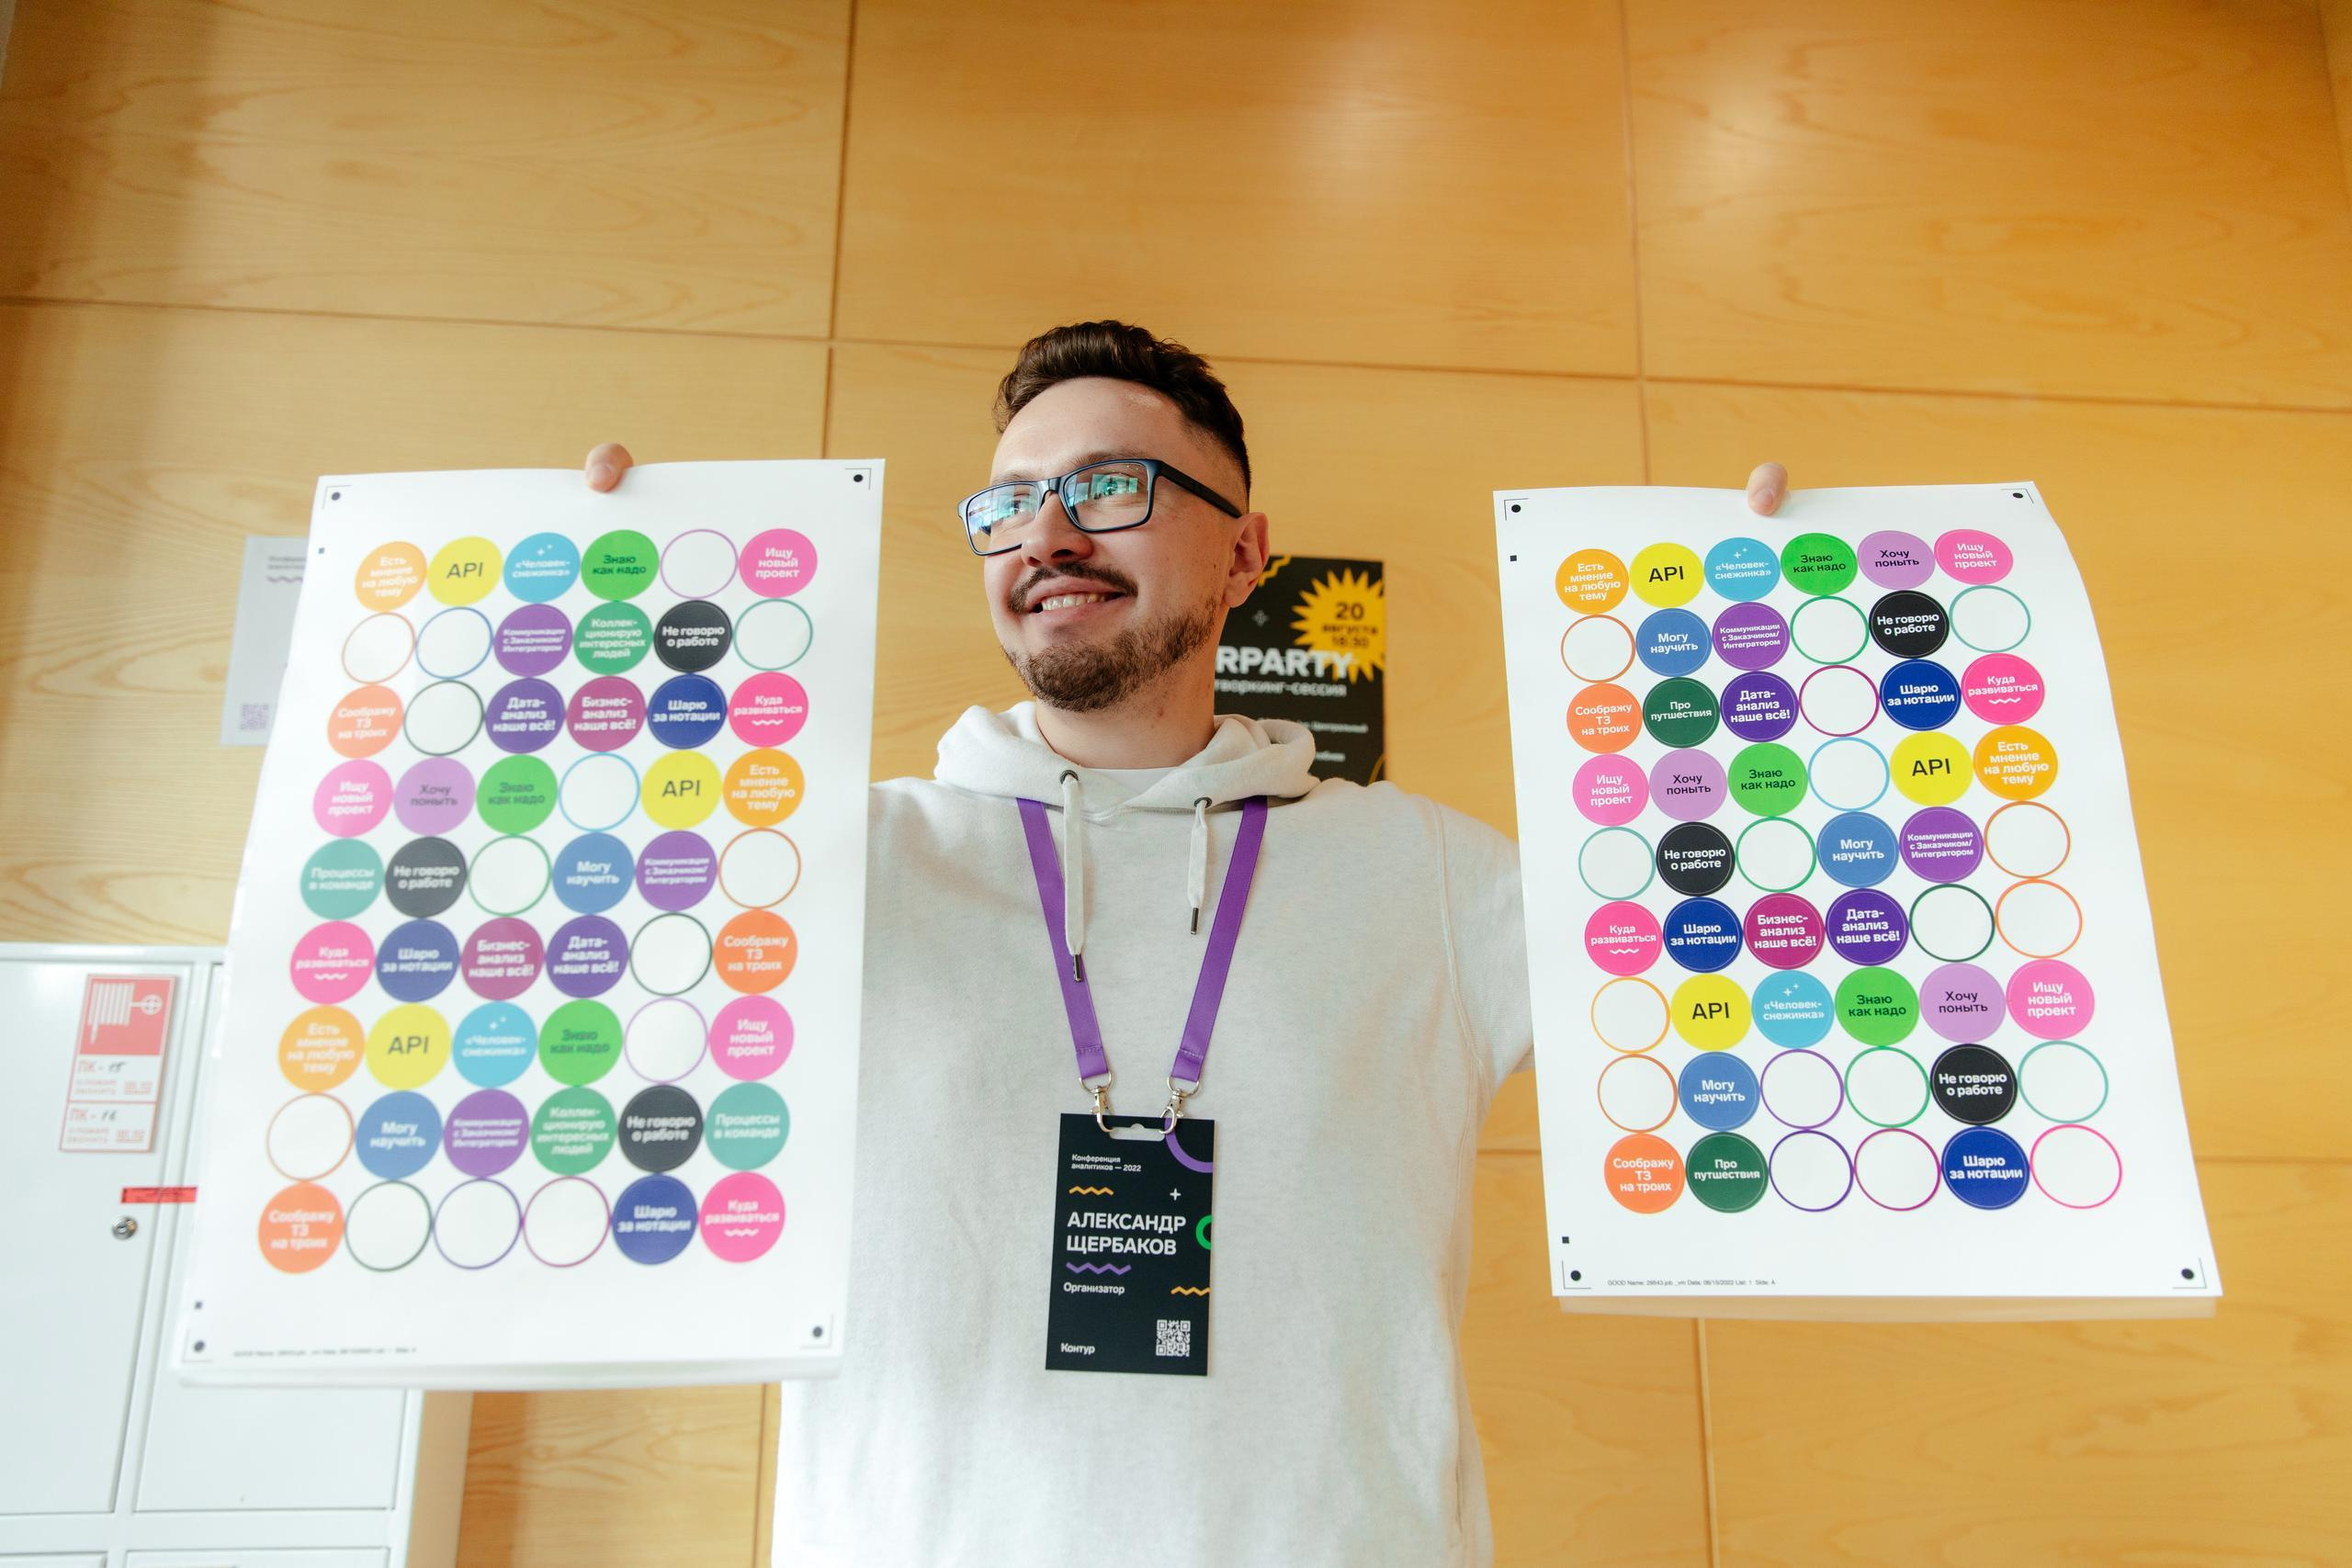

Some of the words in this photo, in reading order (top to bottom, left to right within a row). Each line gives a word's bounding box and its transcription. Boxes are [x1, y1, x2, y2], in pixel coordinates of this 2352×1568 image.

[765, 547, 793, 559] Ищу
[1957, 544, 1986, 552] Ищу
[1801, 555, 1833, 563] Знаю
[1880, 550, 1909, 558] Хочу
[1954, 551, 1994, 559] новый
[603, 554, 636, 565] Знаю
[758, 558, 798, 569] новый
[1577, 563, 1604, 572] Есть
[1715, 562, 1769, 570] «Человек-
[1816, 563, 1846, 571] надо
[1955, 560, 1997, 570] проект
[447, 562, 483, 579] API
[592, 567, 614, 576] как
[616, 566, 647, 576] надо
[755, 569, 800, 580] проект
[1648, 566, 1683, 582] API
[1714, 570, 1771, 580] снежинка»
[1570, 572, 1613, 582] мнение
[1580, 581, 1621, 591] любую
[1579, 592, 1607, 601] тему
[1335, 603, 1365, 621] 20
[1877, 616, 1894, 626] Не
[1894, 615, 1939, 624] говорю
[662, 626, 680, 637] Не
[680, 626, 724, 637] говорю
[1720, 625, 1780, 634] Коммуникации
[1894, 623, 1936, 636] работе
[1657, 633, 1689, 643] Могу
[1727, 631, 1780, 641] Заказчиком/
[666, 637, 676, 648] о
[676, 636, 718, 649] работе
[1723, 640, 1781, 649] Интегратором
[1650, 643, 1698, 654] научить
[1987, 676, 2016, 686] Куда
[1900, 684, 1939, 694] Шарю
[1968, 684, 2038, 695] развиваться
[755, 694, 783, 706] Куда
[1740, 690, 1776, 702] Дата-
[1904, 694, 1954, 705] нотации
[668, 699, 707, 712] Шарю
[735, 705, 801, 716] развиваться
[1576, 705, 1632, 716] Соображу
[1670, 701, 1690, 711] Про
[1736, 701, 1780, 711] анализ
[653, 712, 667, 723] за
[669, 712, 718, 722] нотации
[1596, 716, 1611, 725] ТЗ
[1651, 710, 1712, 721] путшествия
[1731, 714, 1763, 722] наше
[1765, 709, 1790, 720] всё!
[1597, 725, 1630, 735] троих
[1997, 741, 2029, 751] Есть
[1990, 752, 2040, 762] мнение
[1912, 759, 1951, 776] API
[1984, 766, 2000, 774] на
[2003, 762, 2049, 773] любую
[1597, 774, 1623, 784] Ищу
[1673, 774, 1702, 784] Хочу
[1749, 769, 1782, 779] Знаю
[1741, 782, 1762, 790] как
[1765, 780, 1795, 789] надо
[2001, 775, 2035, 785] тему
[662, 780, 700, 796] API
[1591, 784, 1630, 795] новый
[1667, 785, 1711, 795] поныть
[1590, 796, 1633, 807] проект
[1907, 832, 1973, 841] Коммуникации
[1840, 839, 1873, 851] Могу
[1917, 840, 1973, 850] Заказчиком/
[1664, 850, 1680, 860] Не
[1682, 850, 1725, 859] говорю
[1832, 851, 1884, 863] научить
[1911, 850, 1973, 858] Интегратором
[1680, 858, 1722, 871] работе
[1847, 908, 1884, 921] Дата-
[1758, 915, 1808, 925] Бизнес-
[1610, 925, 1635, 935] Куда
[1683, 924, 1722, 935] Шарю
[1842, 921, 1889, 931] анализ
[1760, 927, 1805, 937] анализ
[1837, 934, 1871, 943] наше
[1873, 931, 1900, 942] всё!
[1591, 935, 1656, 944] развиваться
[1670, 938, 1685, 946] за
[1686, 936, 1736, 945] нотации
[1755, 940, 1788, 948] наше
[1790, 936, 1817, 947] всё!
[2032, 982, 2064, 995] Ищу
[1857, 995, 1893, 1005] Знаю
[1946, 991, 1977, 1003] Хочу
[2028, 994, 2073, 1005] новый
[1764, 1001, 1822, 1010] «Человек-
[1939, 1004, 1988, 1013] поныть
[1692, 1002, 1729, 1020] API
[1763, 1011, 1825, 1021] снежинка»
[1849, 1009, 1871, 1017] как
[1874, 1007, 1906, 1017] надо
[2028, 1007, 2076, 1018] проект
[388, 1036, 429, 1055] API
[1939, 1073, 1957, 1084] Не
[1959, 1074, 2007, 1084] говорю
[1702, 1079, 1735, 1092] Могу
[1946, 1087, 1955, 1096] о
[1957, 1083, 2003, 1098] работе
[1694, 1093, 1746, 1104] научить
[1071, 1154, 1121, 1164] Конференция
[1613, 1158, 1674, 1169] Соображу
[1962, 1156, 2006, 1168] Шарю
[1071, 1163, 1114, 1171] аналитиков
[1714, 1159, 1737, 1170] Про
[1634, 1170, 1652, 1180] ТЗ
[1694, 1171, 1760, 1181] путшествия
[1950, 1170, 1965, 1179] за
[1967, 1169, 2023, 1179] нотации
[1620, 1183, 1634, 1191] на
[1636, 1183, 1672, 1193] троих
[1067, 1212, 1187, 1232] АЛЕКСАНДР
[1066, 1235, 1177, 1256] ЩЕРБАКОВ
[1063, 1282, 1125, 1295] Организатор
[1060, 1343, 1095, 1355] Контур
